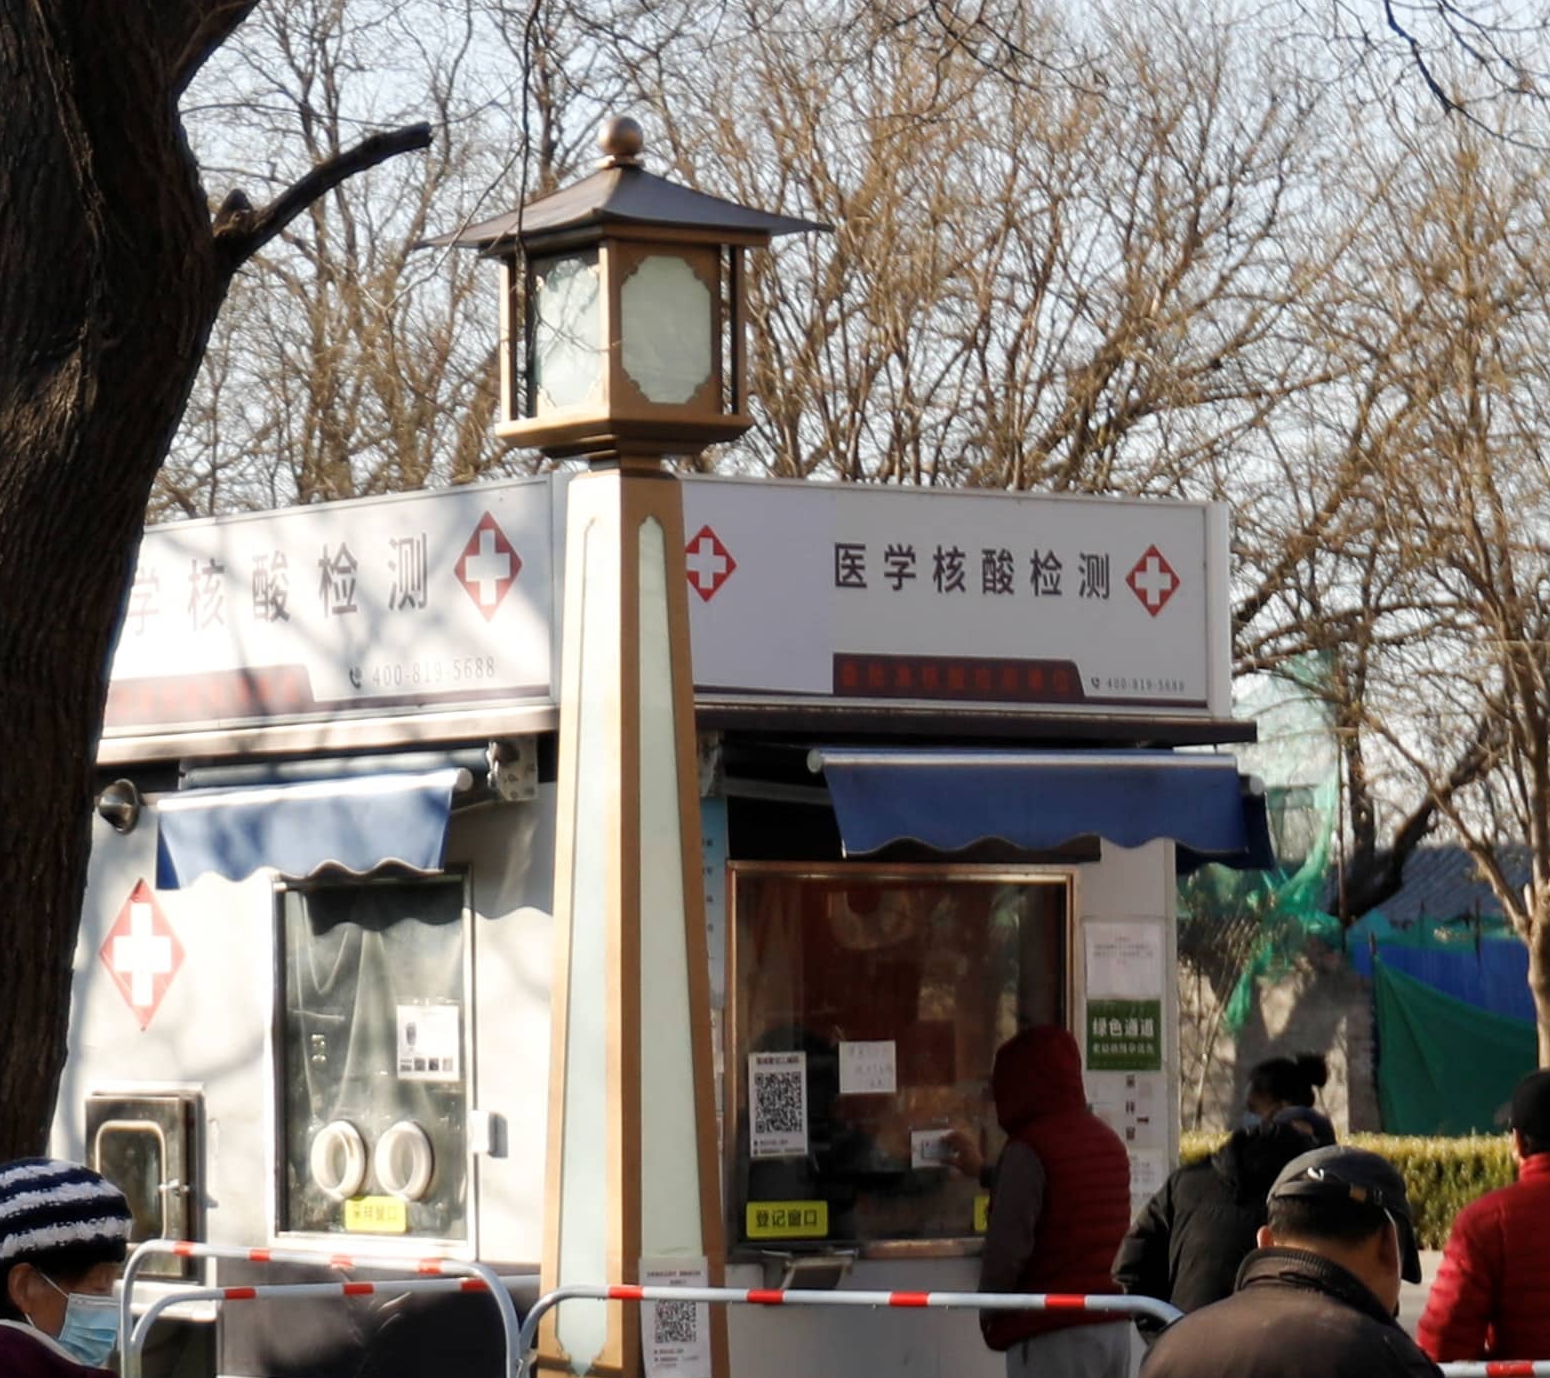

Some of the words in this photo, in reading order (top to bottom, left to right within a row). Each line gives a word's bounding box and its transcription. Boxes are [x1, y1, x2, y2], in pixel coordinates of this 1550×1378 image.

[834, 542, 1111, 599] 医学核酸检测
[372, 656, 497, 688] 400-819-5688
[1092, 1016, 1155, 1038] 绿色通道
[353, 1204, 398, 1222] 采样窗口
[756, 1209, 818, 1228] 登记窗口
